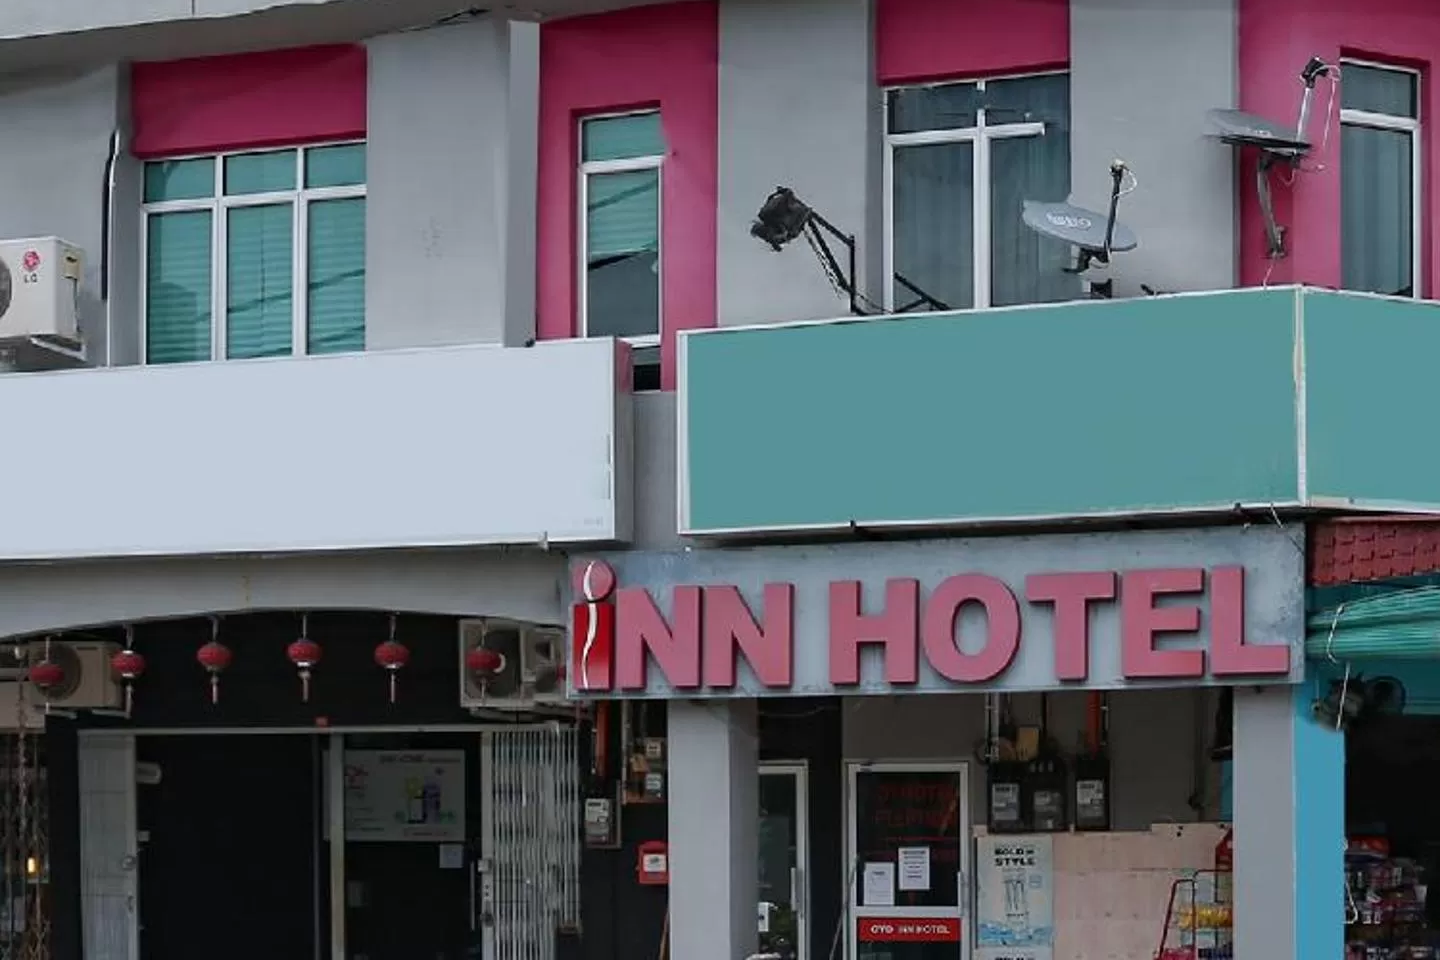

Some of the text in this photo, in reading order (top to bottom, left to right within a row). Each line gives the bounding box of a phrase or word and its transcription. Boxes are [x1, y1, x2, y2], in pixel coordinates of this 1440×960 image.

[829, 565, 1291, 685] HOTEL
[994, 858, 1036, 866] STYLE
[870, 924, 894, 934] OYO
[915, 925, 950, 934] HOTEL
